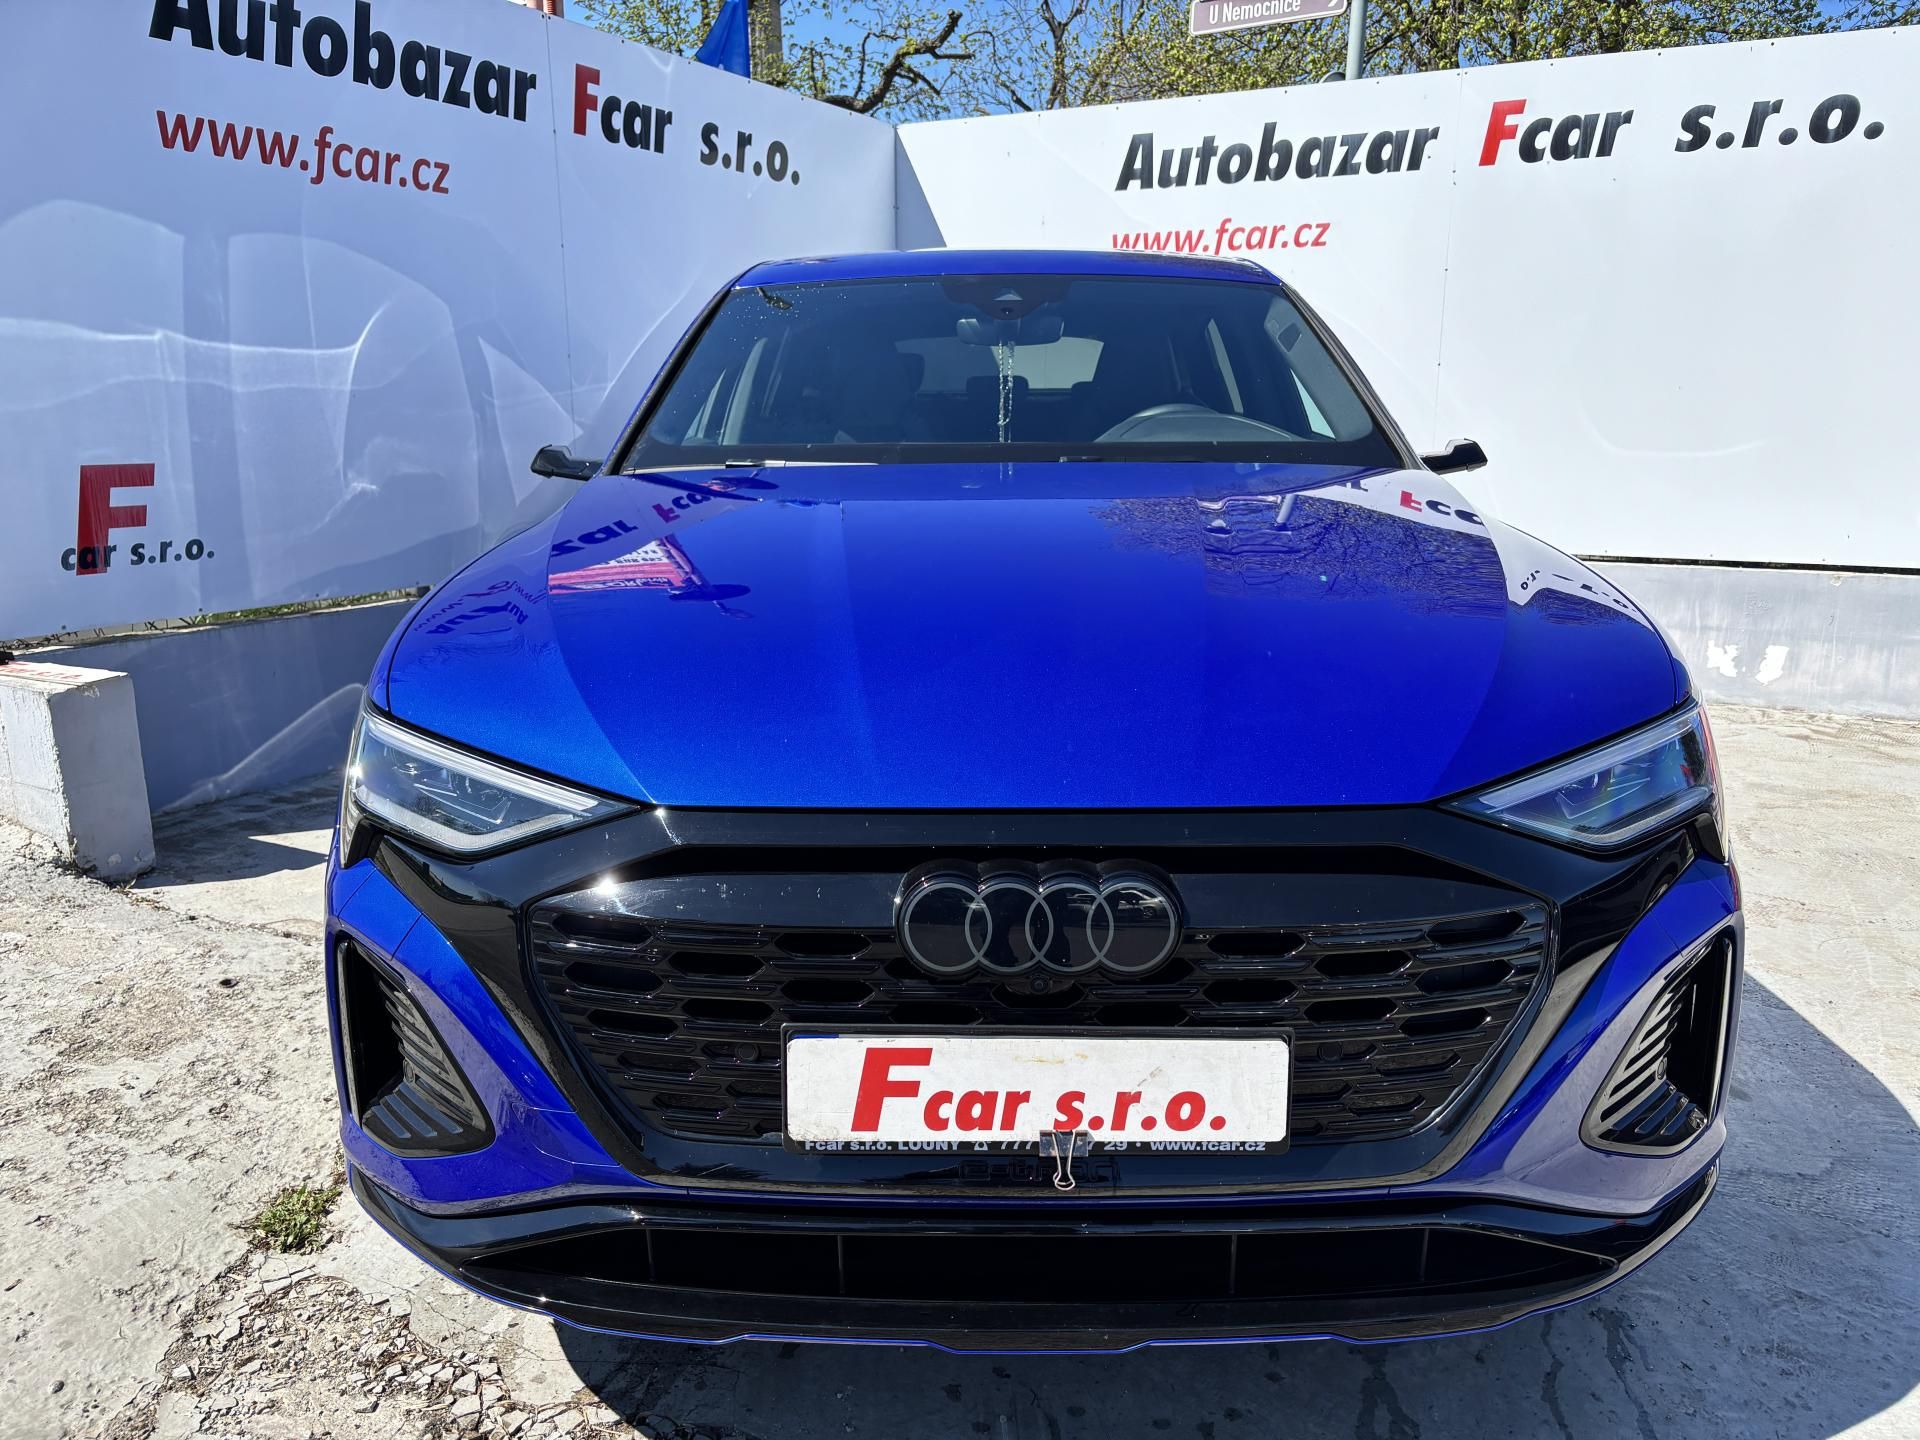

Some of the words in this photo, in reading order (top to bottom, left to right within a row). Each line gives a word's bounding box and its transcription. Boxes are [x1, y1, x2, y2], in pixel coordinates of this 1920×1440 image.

[1209, 4, 1218, 24] U
[1222, 0, 1301, 23] Nemocnice
[148, 0, 537, 122] Autobazar
[573, 63, 673, 154] Fcar
[700, 122, 800, 185] s.r.o.
[156, 110, 450, 194] www.fcar.cz
[1114, 121, 1440, 191] Autobazar
[1478, 99, 1634, 167] Fcar
[1675, 93, 1885, 153] s.r.o.
[1112, 218, 1331, 255] www.fcar.cz
[131, 539, 214, 566] s.r.o.
[851, 1047, 1031, 1132] Fcar
[1053, 1090, 1227, 1132] s.r.o.
